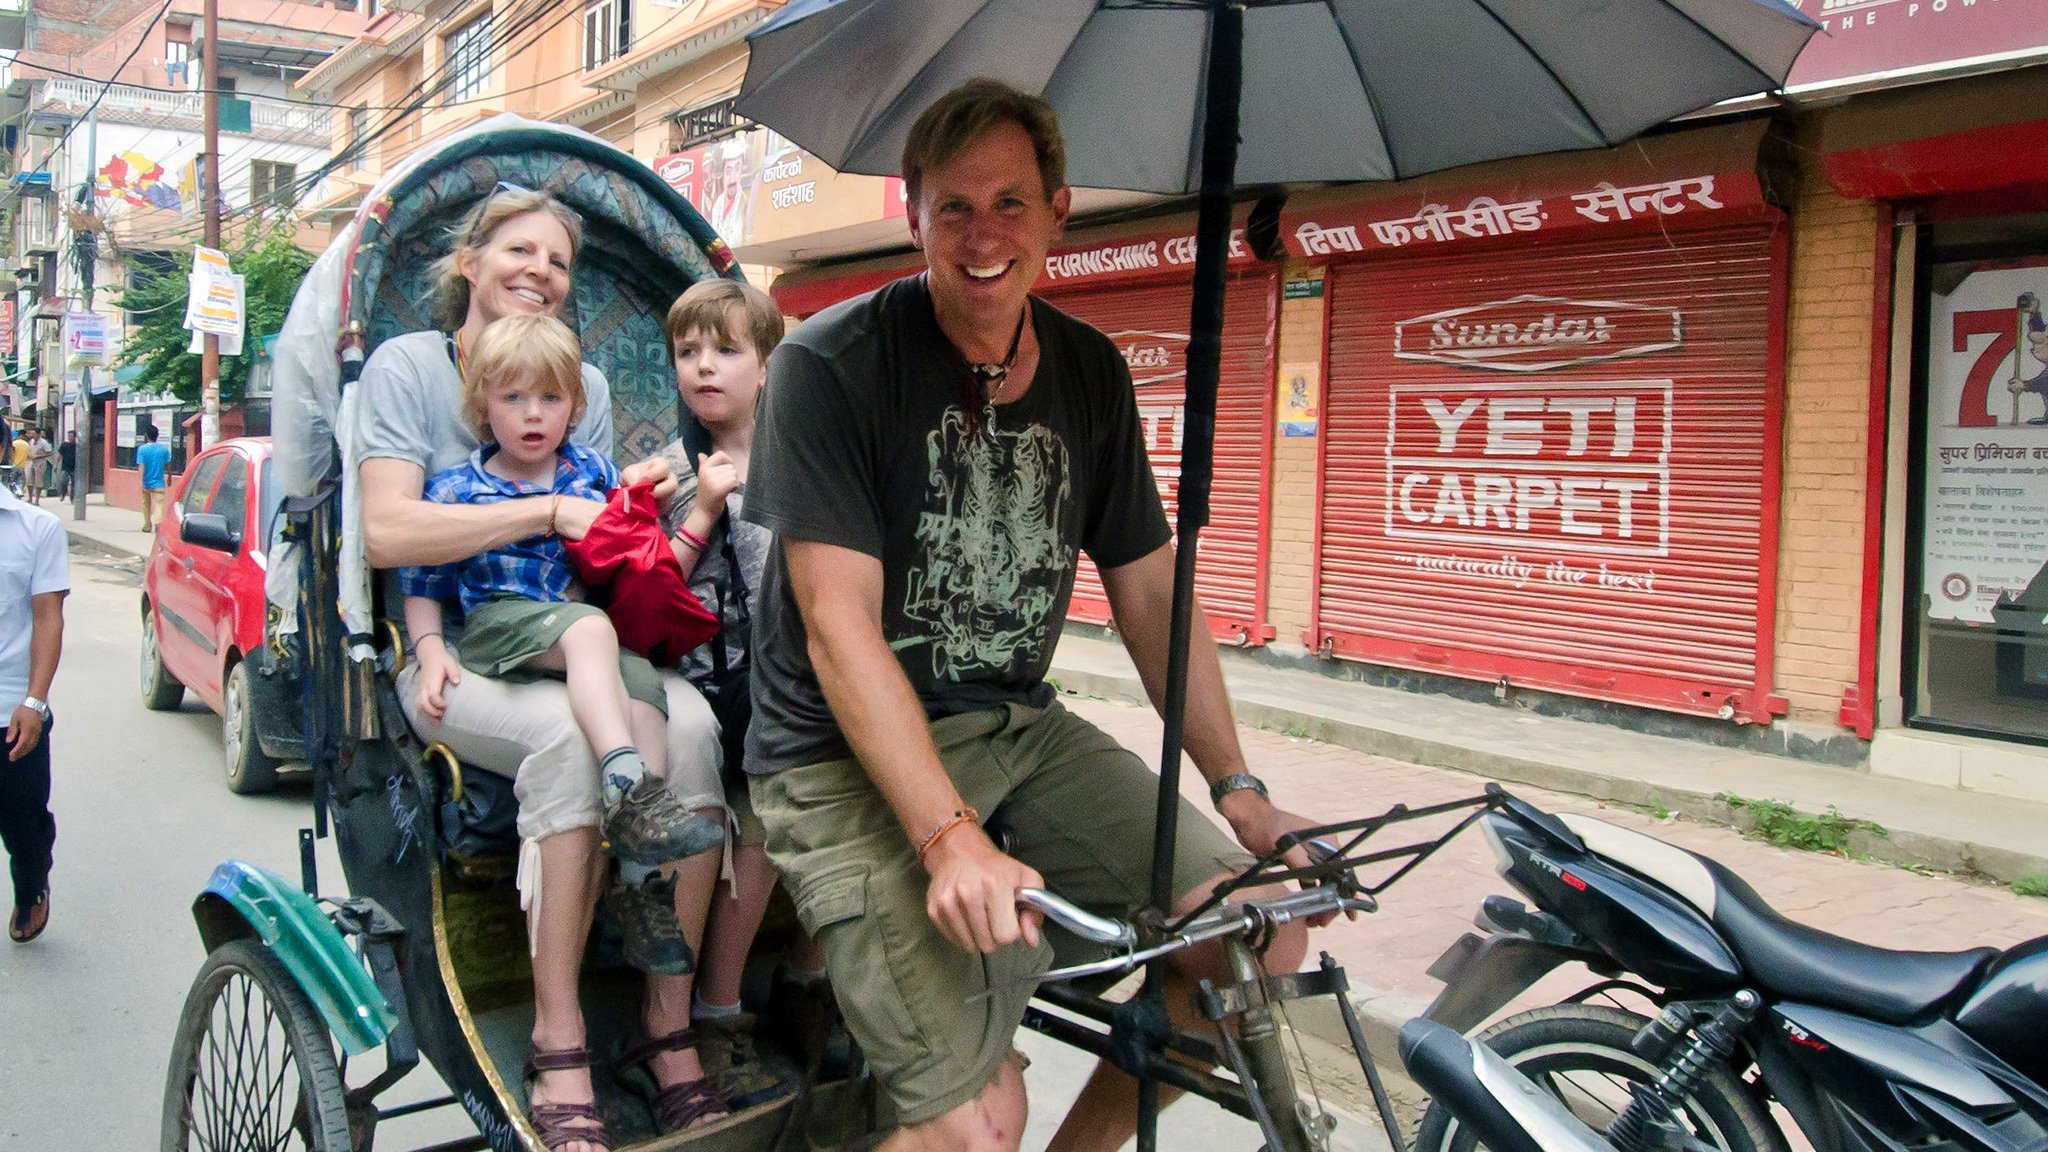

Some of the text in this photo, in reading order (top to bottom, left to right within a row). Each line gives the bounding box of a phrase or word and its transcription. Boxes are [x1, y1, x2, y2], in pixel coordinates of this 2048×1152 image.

[1045, 241, 1159, 280] FURNISHING
[1952, 307, 2018, 428] 7
[1419, 396, 1638, 457] YETI
[1399, 471, 1649, 538] CARPET
[1544, 560, 1589, 585] the
[1598, 563, 1657, 594] best
